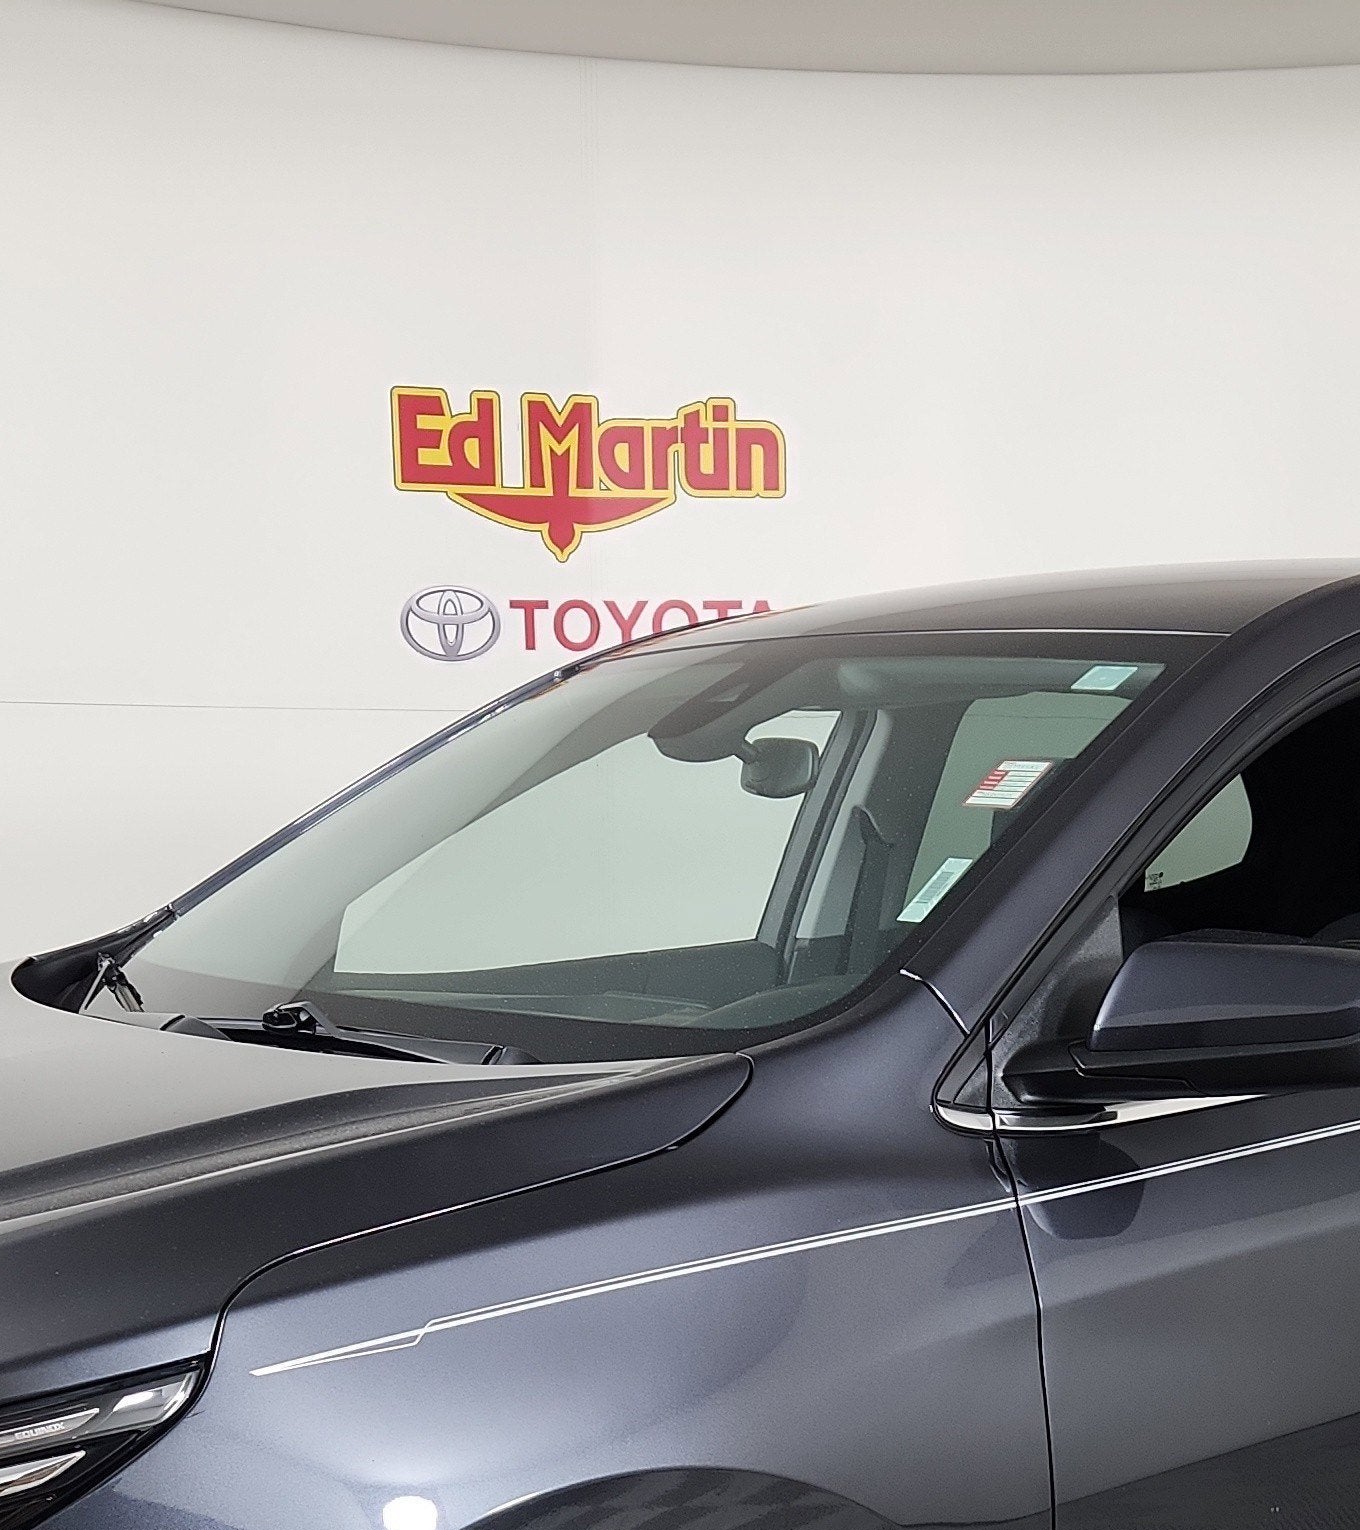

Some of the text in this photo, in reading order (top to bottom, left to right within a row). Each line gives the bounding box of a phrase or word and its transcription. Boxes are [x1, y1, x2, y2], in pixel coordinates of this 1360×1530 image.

[391, 386, 786, 498] Ed Martin
[510, 599, 771, 652] TOYOT
